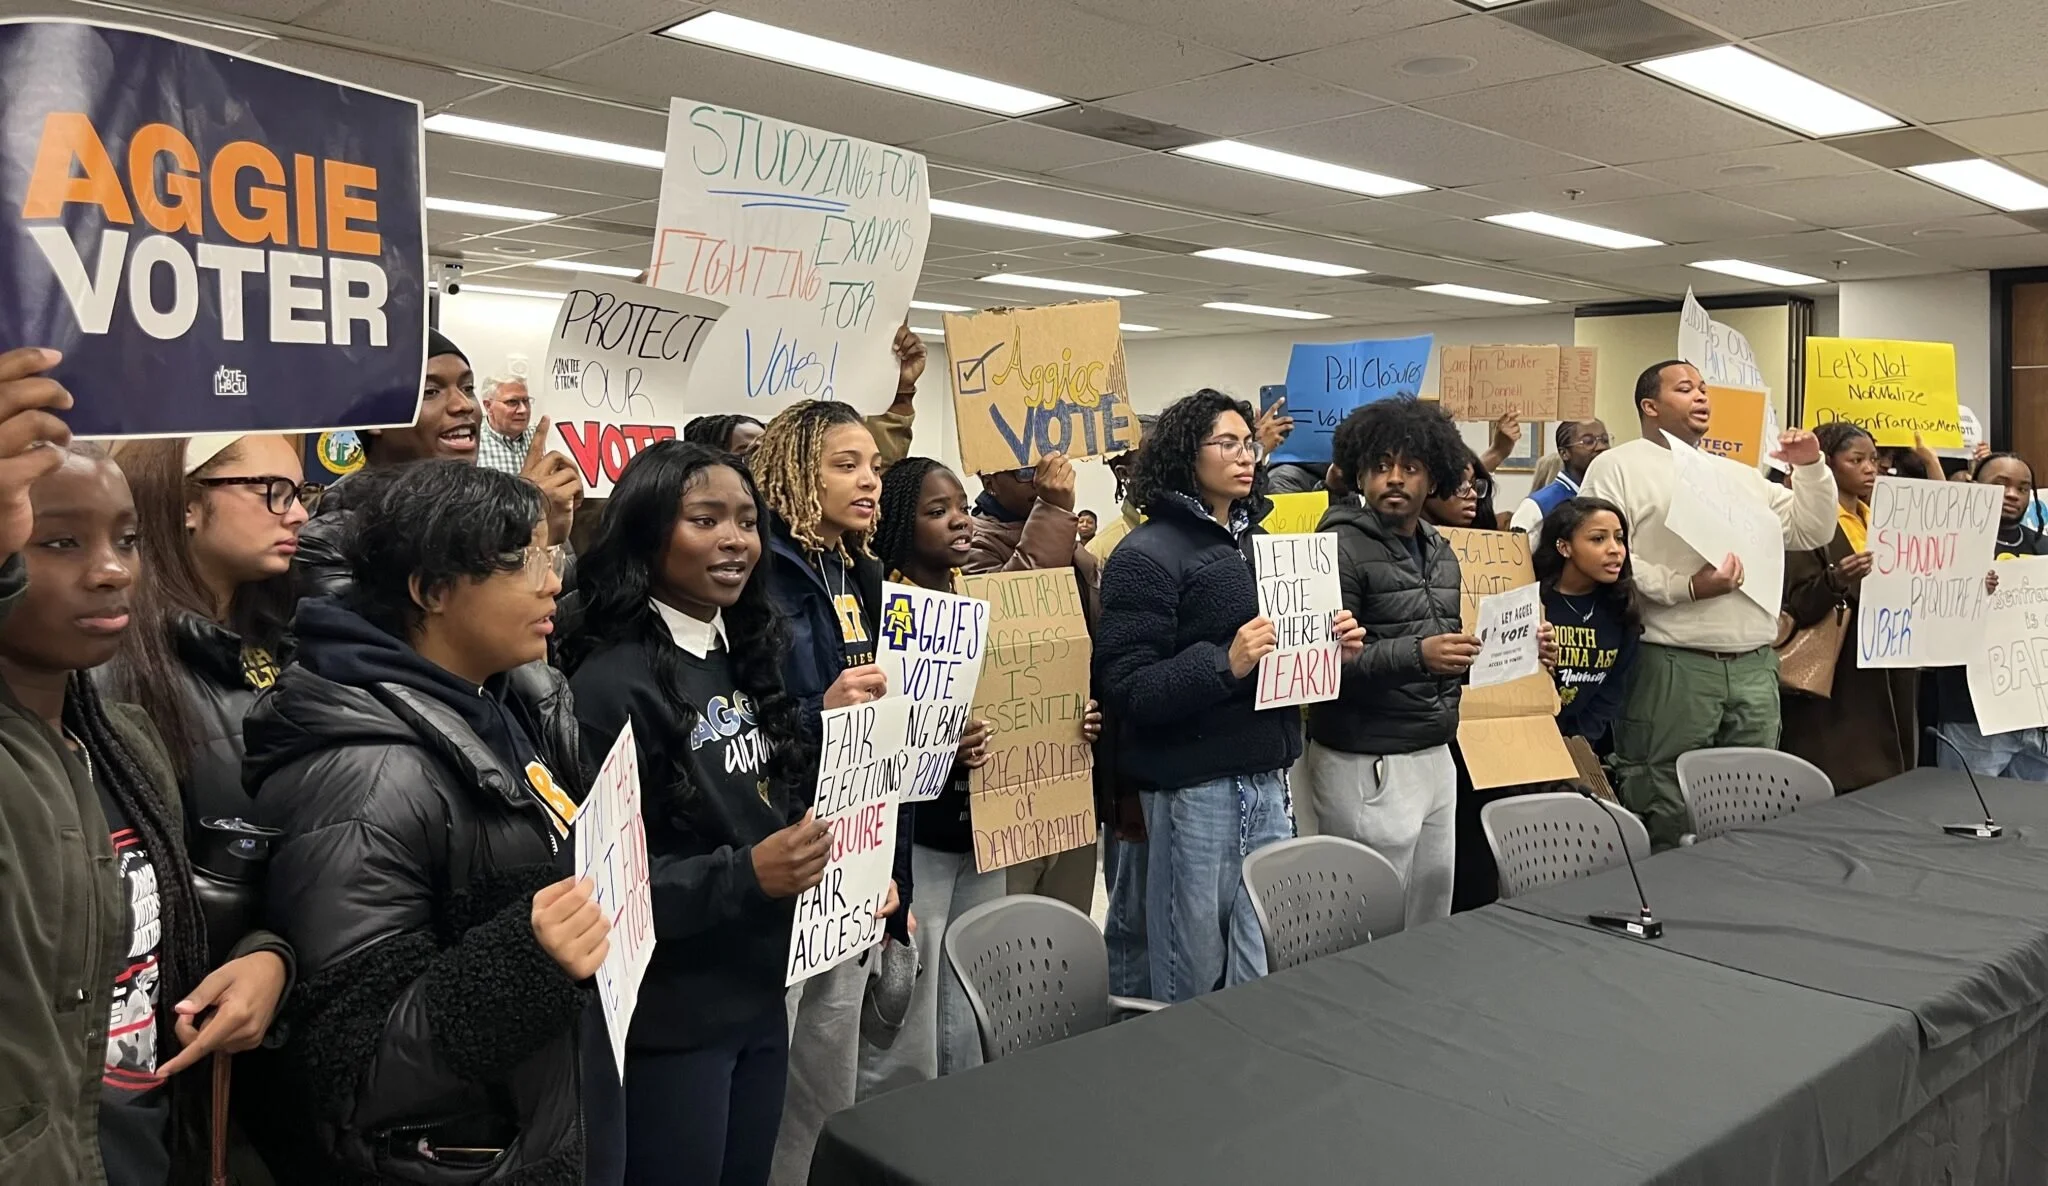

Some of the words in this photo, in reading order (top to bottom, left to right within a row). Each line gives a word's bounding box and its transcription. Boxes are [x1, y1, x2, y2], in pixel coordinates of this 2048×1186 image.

[689, 105, 873, 199] STUDYING
[874, 150, 921, 205] FOR
[22, 112, 382, 256] AGGIE
[651, 228, 821, 300] FIGHTING
[815, 215, 914, 271] EXAMS
[28, 226, 389, 347] VOTER
[820, 280, 877, 334] FOR
[561, 289, 718, 363] PROTECT
[217, 365, 241, 382] VOTE
[219, 379, 245, 393] HBCU
[992, 325, 1104, 410] Aggies
[1326, 355, 1358, 393] Poll
[1362, 357, 1422, 389] Closures
[1491, 350, 1540, 372] Bunker
[1873, 351, 1912, 380] Not
[581, 360, 656, 418] OUR
[555, 420, 677, 489] VOT
[988, 392, 1130, 467] VOTE
[1698, 438, 1743, 453] TECT
[1872, 481, 1996, 534] DEMOCRACY
[1256, 539, 1299, 581] LET
[1307, 536, 1331, 575] US
[1449, 529, 1524, 566] GGIES
[1261, 577, 1312, 618] VOTE
[982, 626, 1070, 677] ACCESS
[1500, 624, 1530, 645] VOTE
[1557, 646, 1590, 668] LINA
[1861, 607, 1912, 661] UBER
[902, 657, 962, 702] VOTE
[1002, 666, 1043, 704] IS
[1260, 645, 1341, 704] LEARN
[690, 690, 761, 751] AGG
[823, 706, 876, 773] FAIR
[932, 702, 969, 747] BACK
[815, 748, 909, 820] ELECTIONS
[908, 751, 956, 797] POLLS
[981, 740, 1091, 803] REGARDLESS
[826, 801, 886, 863] QUIRE
[974, 808, 1095, 872] DEMOGRAPHIC
[799, 867, 847, 923] FAIR
